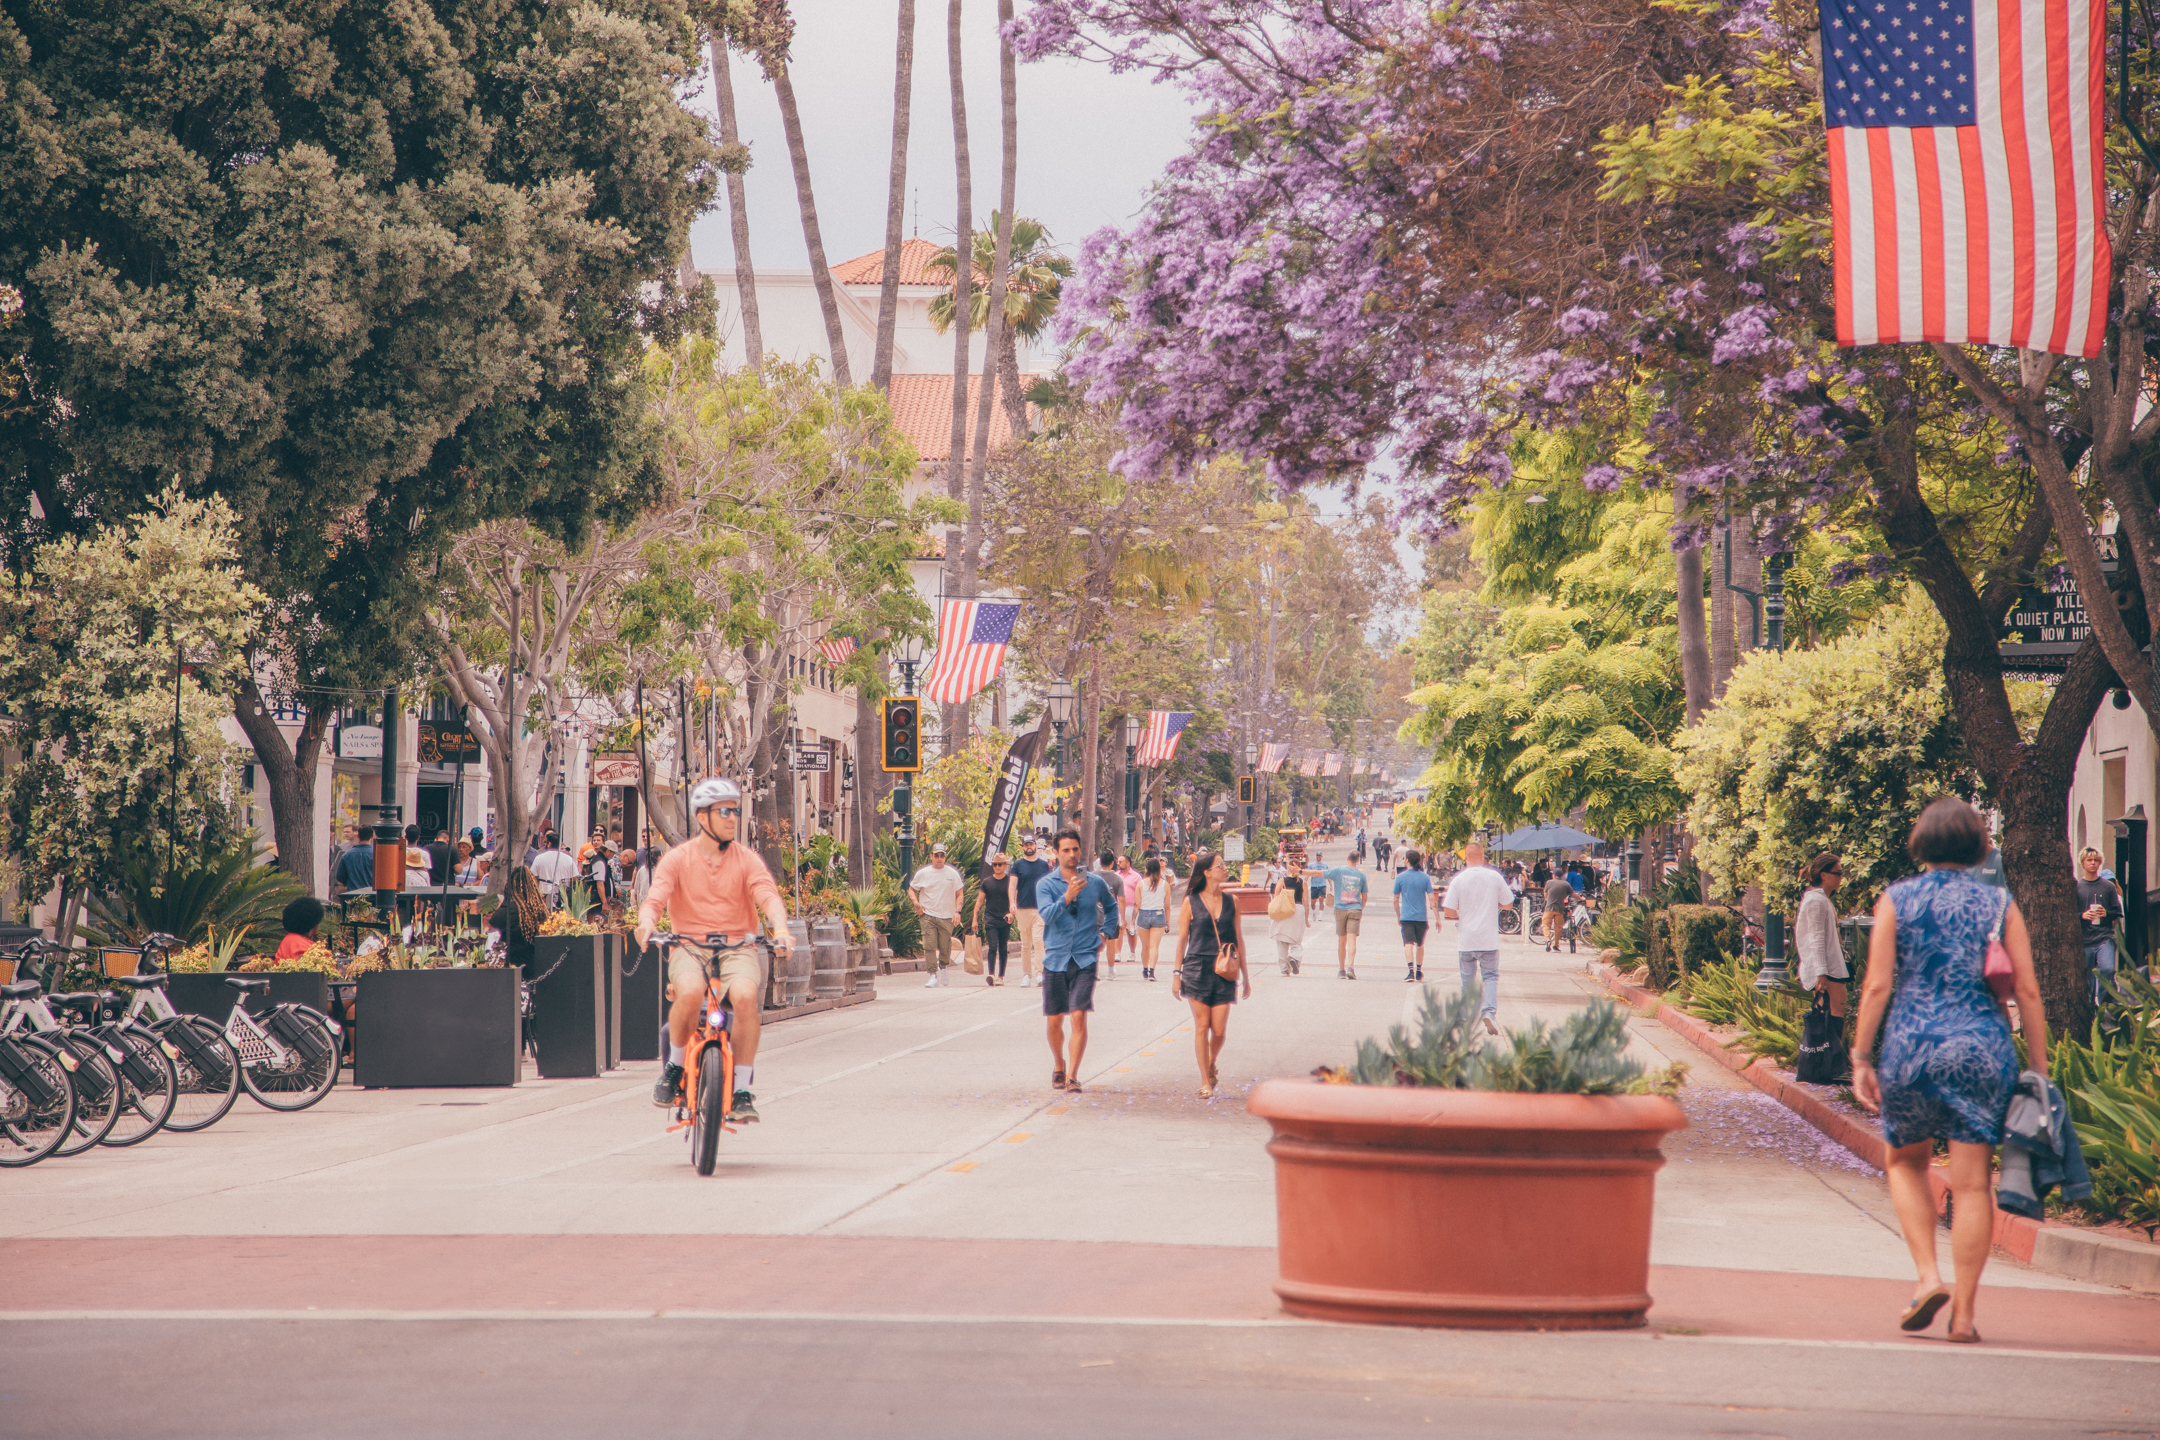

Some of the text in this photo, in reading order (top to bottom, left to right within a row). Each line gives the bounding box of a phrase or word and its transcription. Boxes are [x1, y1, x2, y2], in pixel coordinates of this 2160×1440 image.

[2056, 595, 2084, 609] KILL
[2004, 610, 2089, 626] A QUIET PLACE
[2041, 626, 2091, 641] NOW HIR
[611, 768, 622, 779] THE
[984, 755, 1023, 867] Bianchi
